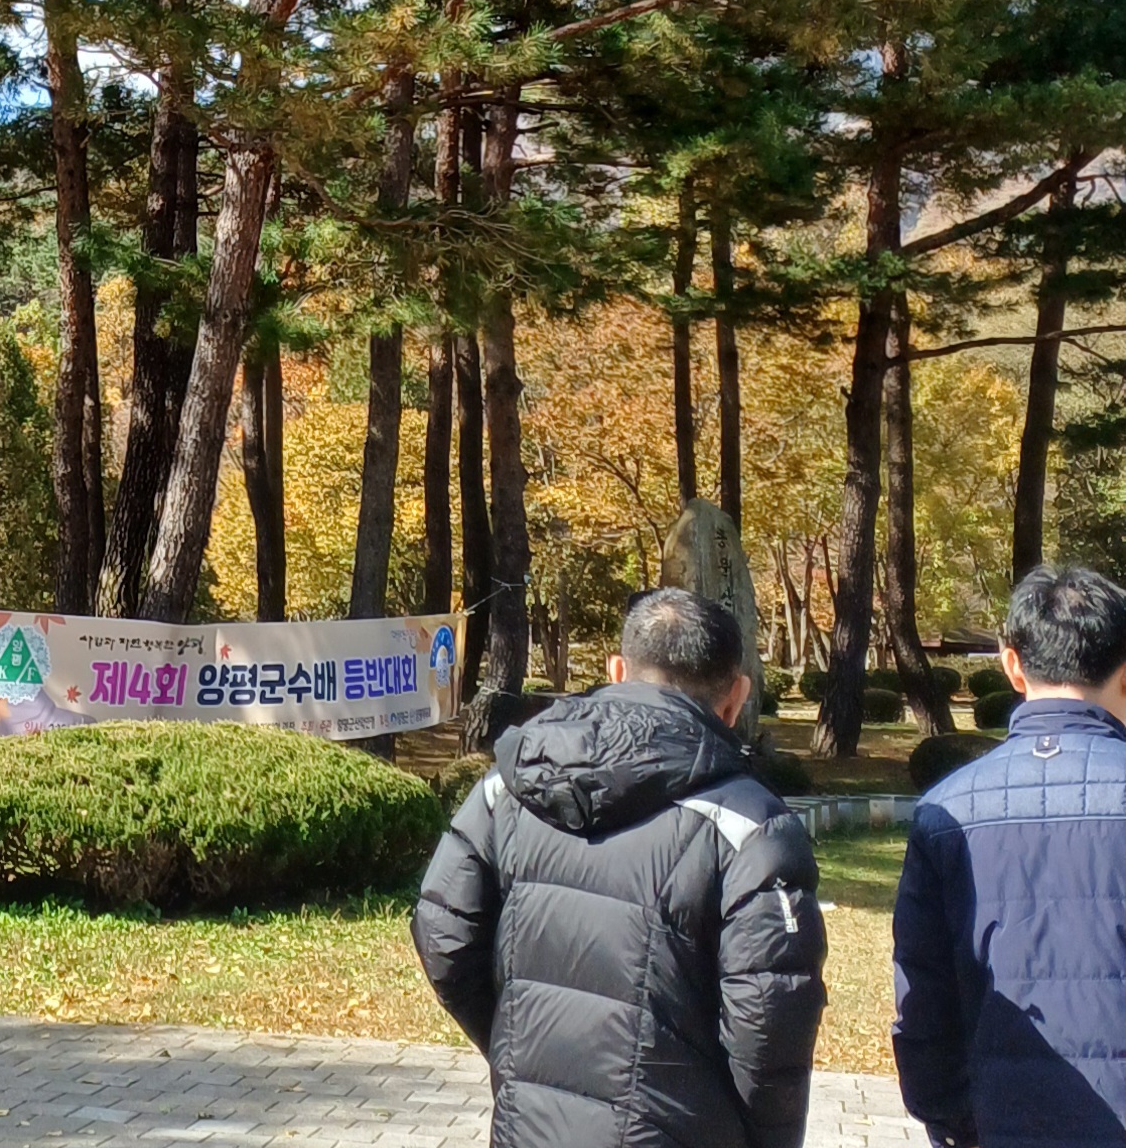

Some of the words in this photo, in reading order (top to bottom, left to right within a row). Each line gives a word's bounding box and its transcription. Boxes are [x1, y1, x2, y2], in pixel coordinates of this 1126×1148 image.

[12, 639, 24, 666] 양평
[27, 668, 37, 681] F
[89, 661, 188, 706] 제4회
[197, 660, 337, 705] 양평군수배
[344, 654, 417, 700] 등반대회
